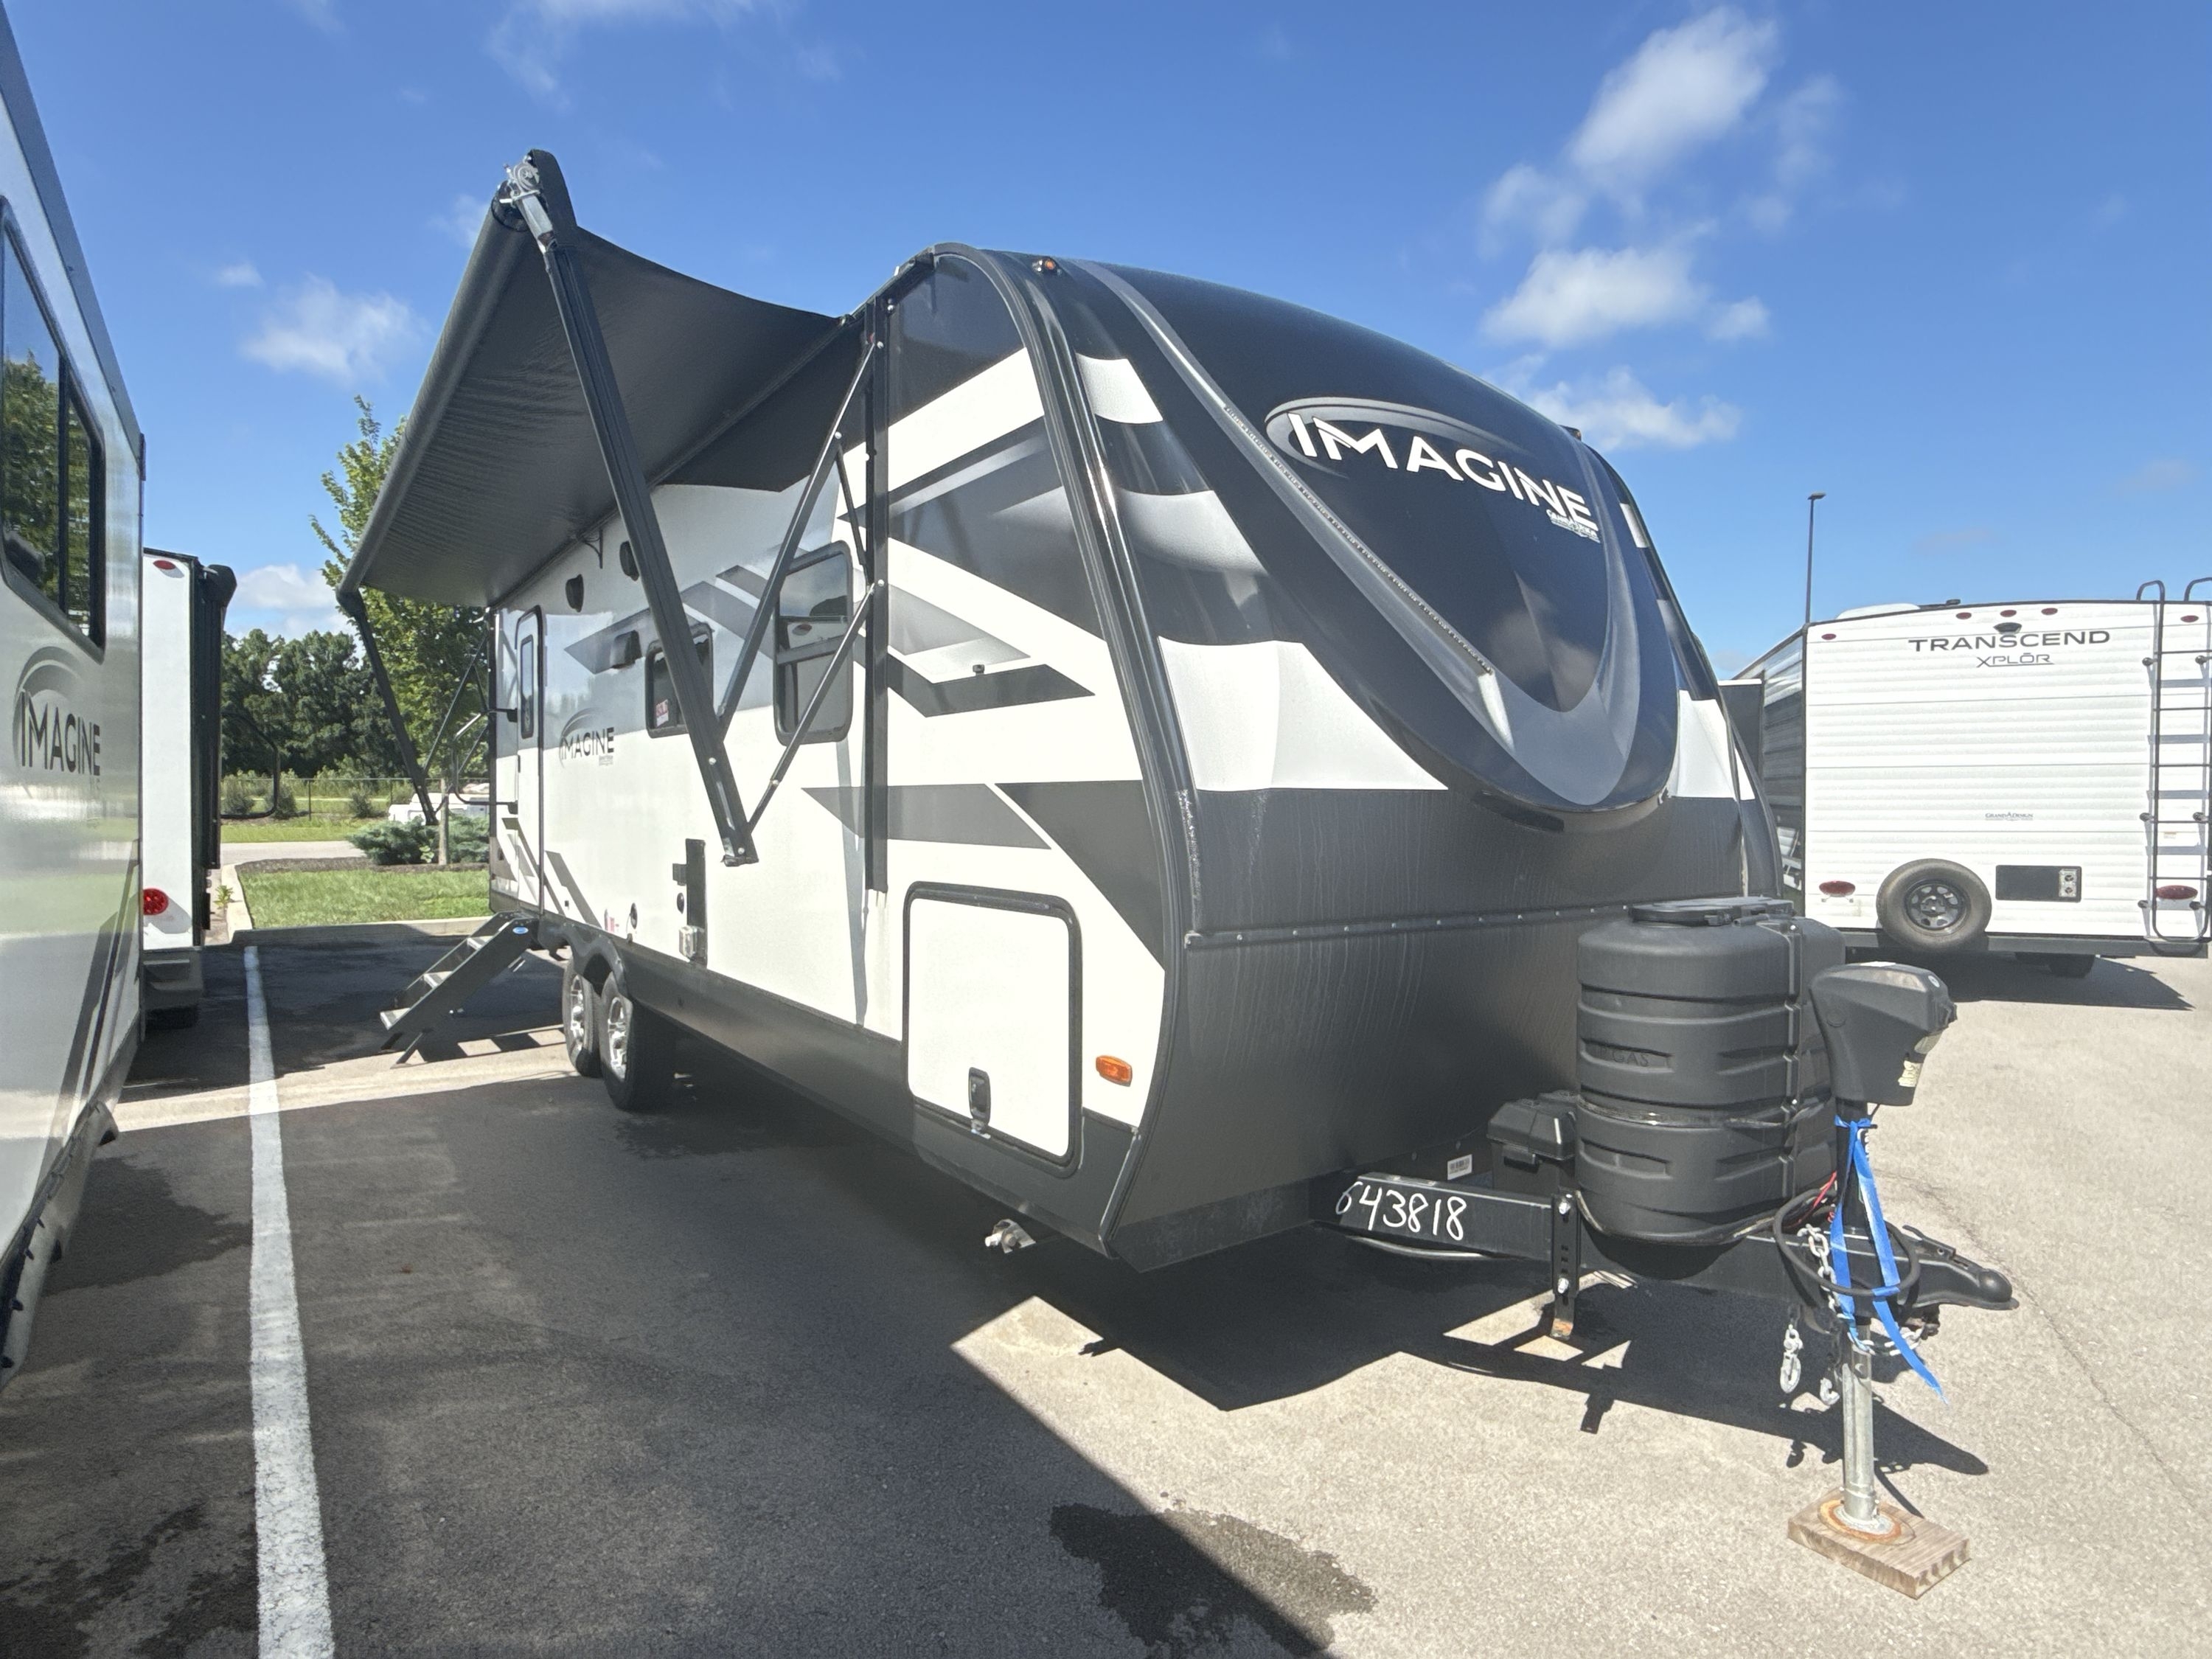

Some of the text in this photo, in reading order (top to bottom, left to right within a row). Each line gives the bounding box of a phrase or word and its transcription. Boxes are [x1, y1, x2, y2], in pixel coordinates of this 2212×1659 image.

[1287, 412, 1599, 532] IMAGINE
[1908, 630, 2110, 652] TRANSCEND
[21, 690, 100, 776] IMAGINE
[560, 727, 614, 760] IMAGINE
[1335, 1181, 1467, 1240] 643818
